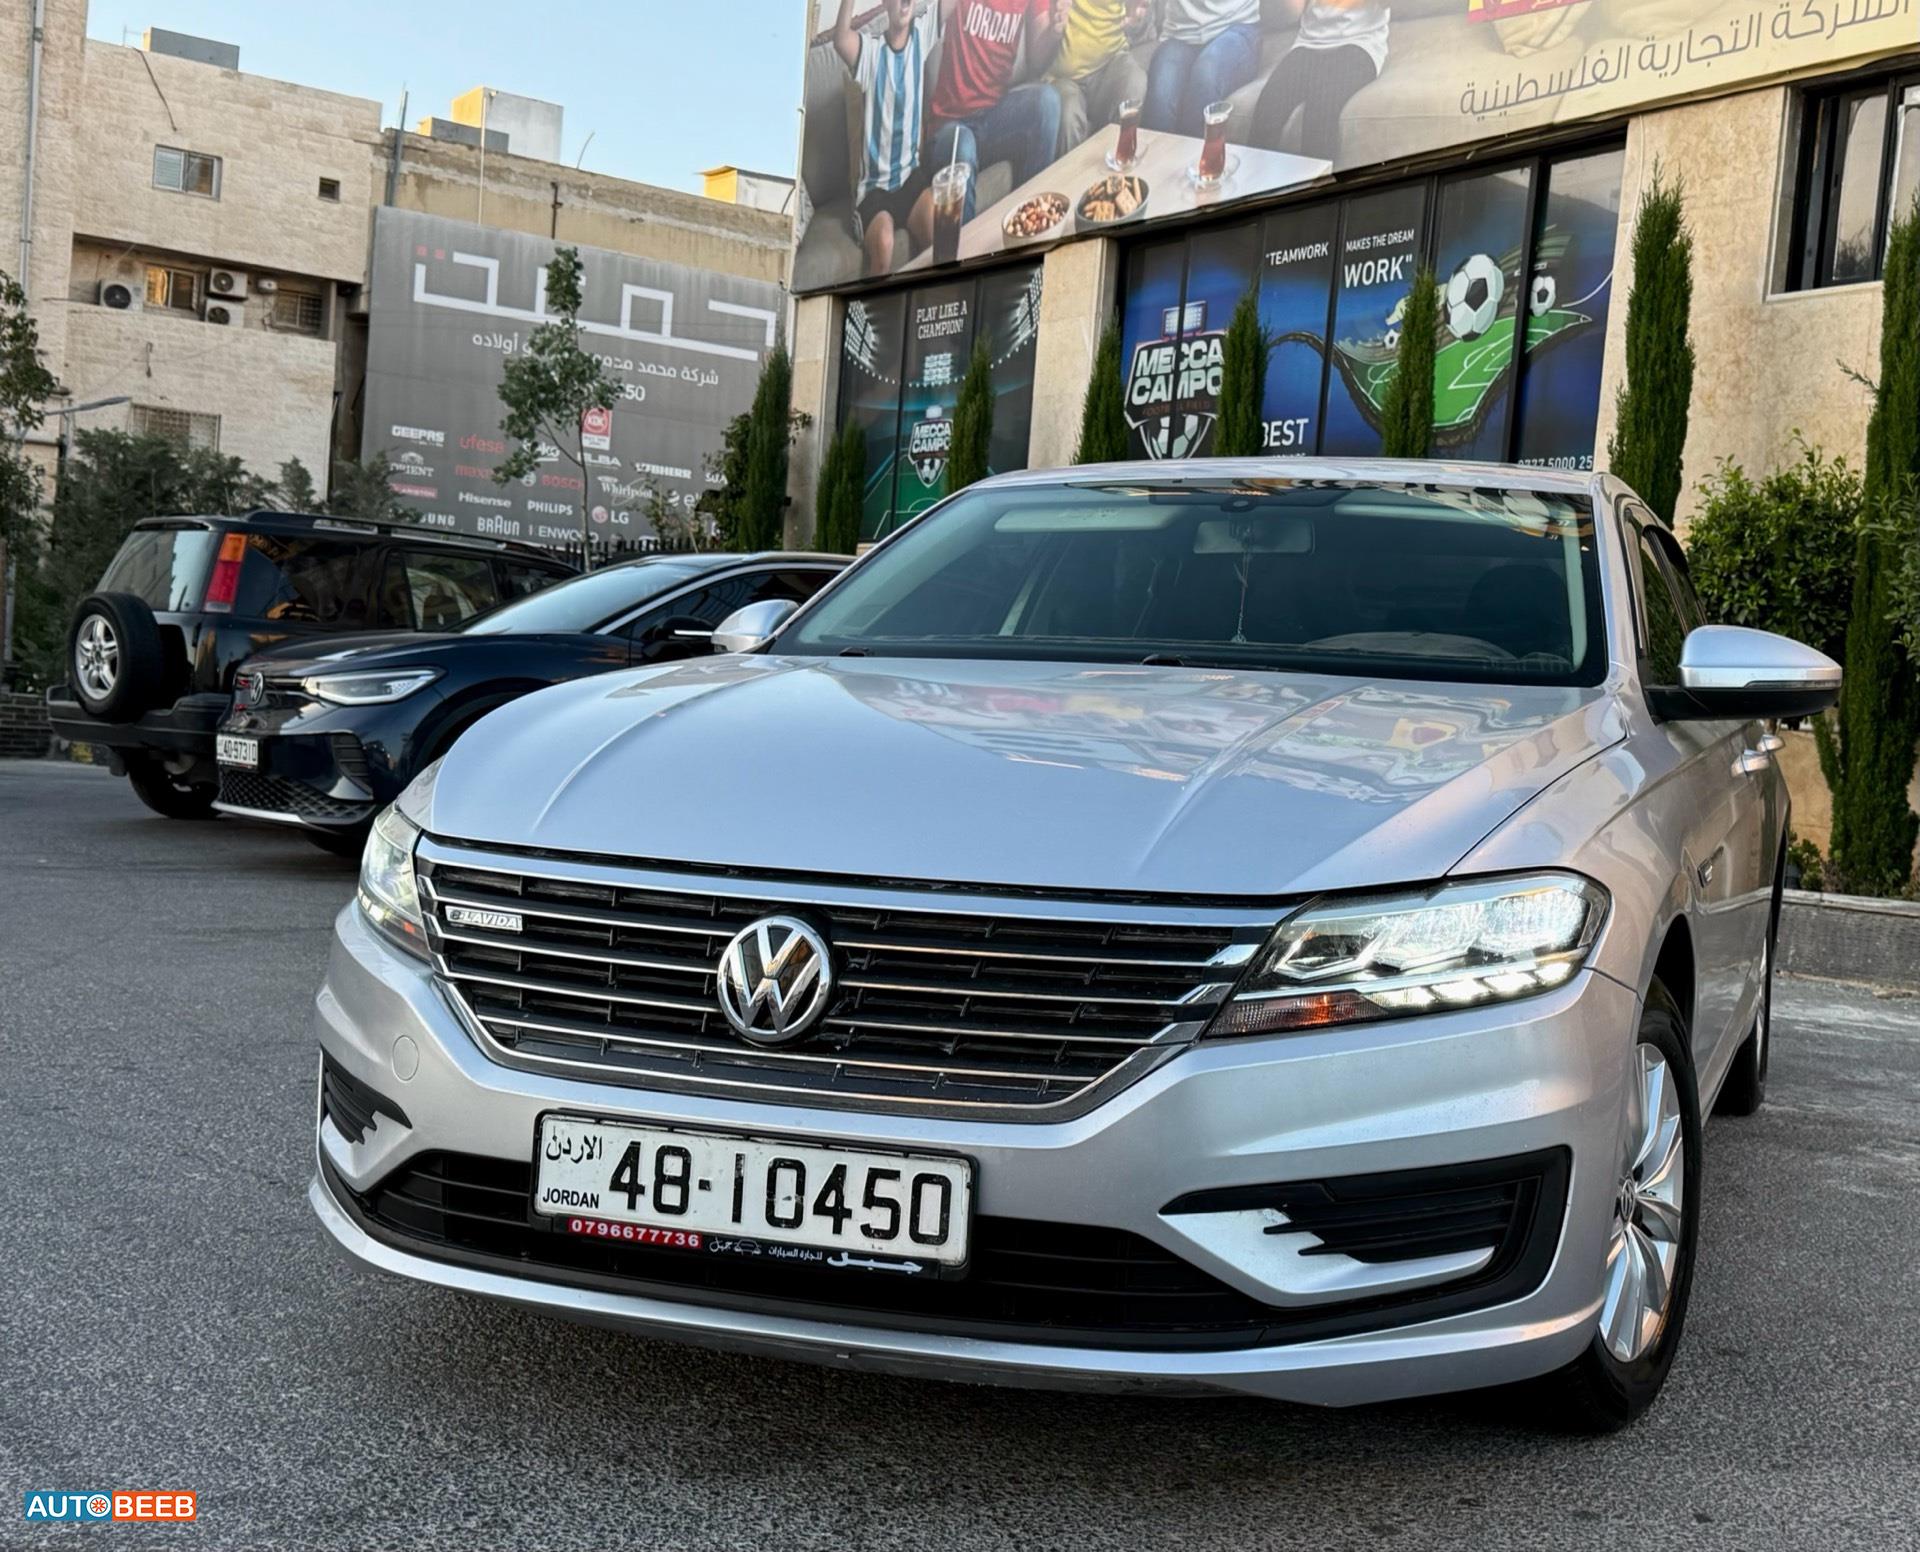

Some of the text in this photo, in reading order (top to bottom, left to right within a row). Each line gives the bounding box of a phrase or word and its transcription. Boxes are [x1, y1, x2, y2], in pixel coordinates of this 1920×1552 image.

[963, 1, 1022, 43] JORDAN
[1639, 12, 1762, 78] التجارية
[1460, 44, 1630, 122] الفلسطينية
[1345, 228, 1415, 252] MAKES THE DREAM
[916, 300, 968, 324] PLAY LIKE A
[917, 318, 965, 340] CHAMPION!
[472, 332, 519, 355] أولاده
[1135, 338, 1225, 377] MECCA
[637, 360, 678, 379] محمد
[680, 364, 720, 387] شركة
[1131, 366, 1223, 405] CAMPO
[391, 425, 445, 443] GEEPAS
[914, 422, 952, 439] MECCA
[911, 434, 952, 453] CAMPO
[1578, 455, 1594, 470] 25
[458, 491, 512, 509] Hisense
[601, 481, 654, 500] Whirlpool
[527, 500, 574, 516] PHILIPS
[610, 510, 630, 525] LG
[477, 514, 521, 537] BRAUN
[542, 1187, 600, 1209] JORDAN
[571, 1219, 700, 1247] 0796677736
